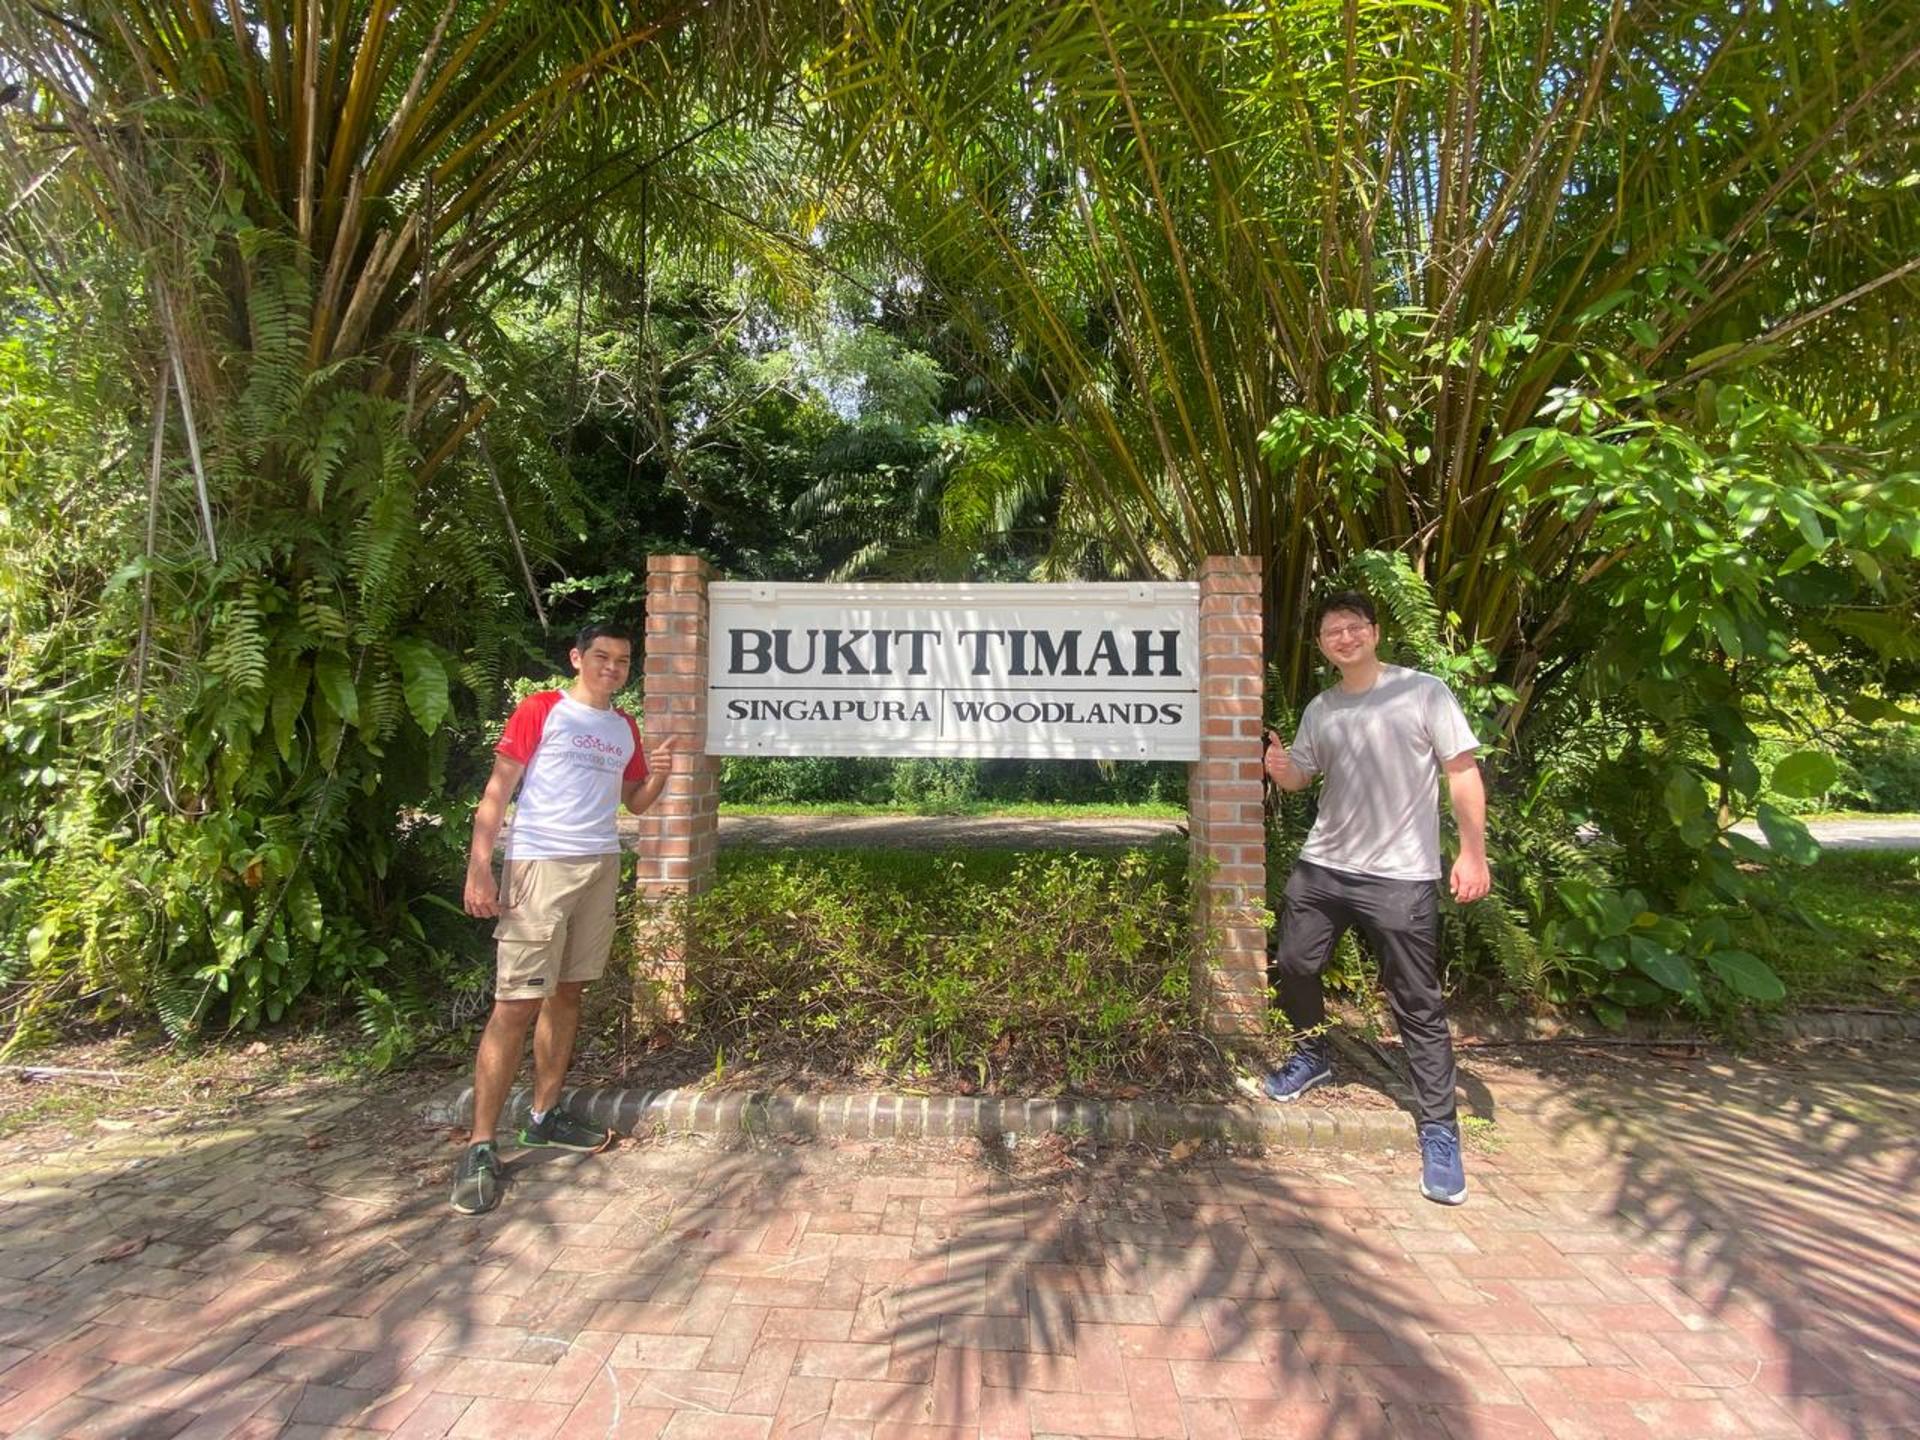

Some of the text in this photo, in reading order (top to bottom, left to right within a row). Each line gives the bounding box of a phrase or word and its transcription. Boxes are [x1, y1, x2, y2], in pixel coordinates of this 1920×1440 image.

[728, 629, 1182, 677] BUKIT TIMAH
[726, 699, 932, 722] SINGAPURA
[953, 702, 1183, 725] WOODLANDS
